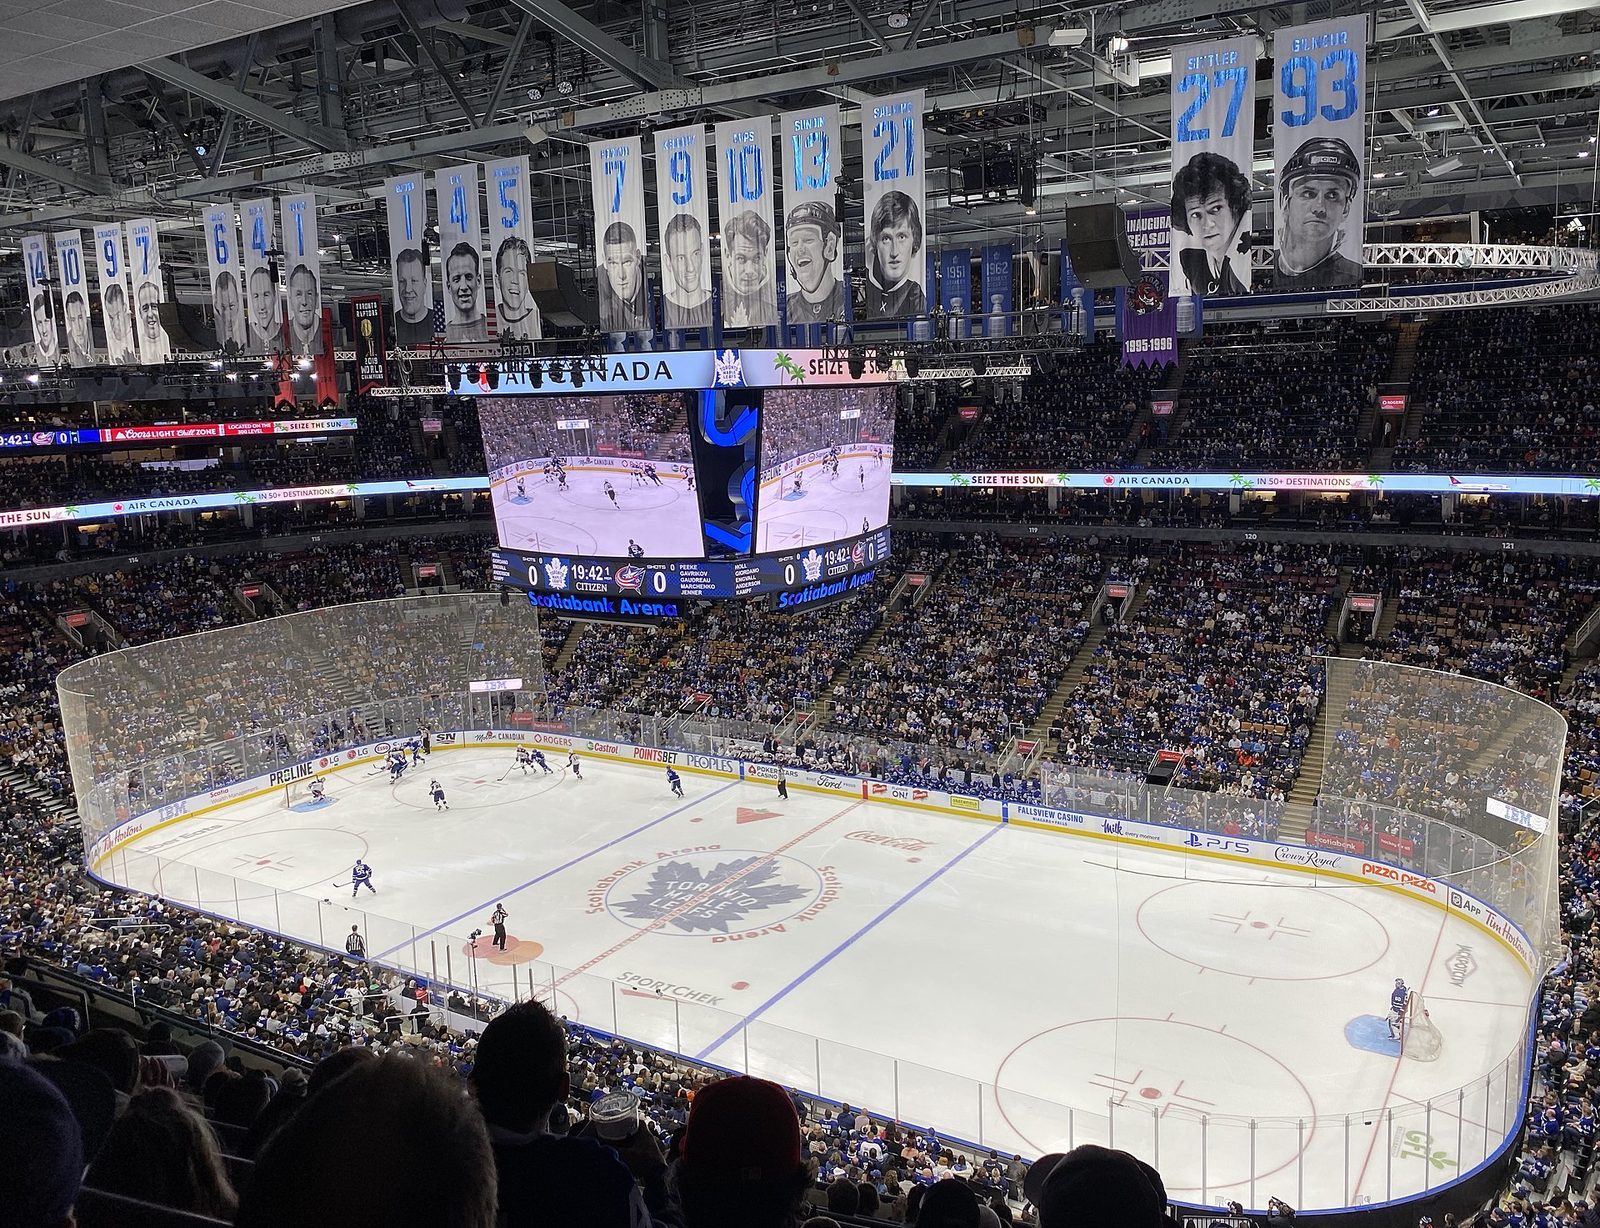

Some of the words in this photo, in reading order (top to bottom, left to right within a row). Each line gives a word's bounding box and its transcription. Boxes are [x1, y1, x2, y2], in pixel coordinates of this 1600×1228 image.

[1280, 48, 1360, 128] 93
[1176, 66, 1249, 144] 27
[873, 117, 916, 182] 21
[791, 131, 831, 192] 13
[670, 149, 693, 206] 9
[725, 144, 764, 204] 10
[604, 159, 627, 213] 7
[449, 186, 468, 234] 4
[498, 178, 520, 229] 5
[402, 194, 413, 241] 1
[1127, 215, 1172, 232] INAUGURA
[251, 216, 267, 259] 4
[294, 213, 305, 256] 1
[213, 223, 230, 265] 6
[103, 239, 118, 278] 9
[135, 235, 150, 276] 7
[27, 250, 46, 288] 14
[61, 248, 81, 286] 10
[946, 265, 966, 278] 1951
[986, 261, 1009, 275] 1962
[1124, 337, 1173, 353] 1995-1996
[360, 364, 383, 375] WORLD
[364, 357, 379, 366] 2019
[809, 358, 844, 376] SEIZE
[124, 429, 152, 440] Coors
[151, 430, 176, 438] LIGHT
[196, 428, 217, 436] ZONE
[290, 422, 310, 430] SEIZE
[60, 433, 68, 444] 0
[971, 475, 998, 485] SEIZE
[1000, 475, 1020, 484] THE
[1022, 475, 1044, 484] SUN
[1119, 476, 1139, 485] AIR
[1141, 476, 1190, 485] CANADA
[1257, 477, 1266, 485] IN
[1268, 477, 1284, 485] 50+
[1286, 477, 1351, 487] DESTINATIONS
[283, 488, 335, 498] DESTINATIONS
[128, 502, 147, 510] AIR
[149, 498, 198, 508] CANADA
[0, 513, 22, 524] THE
[26, 511, 51, 521] SUN
[868, 542, 874, 562] 0
[1501, 541, 1514, 550] 121
[824, 546, 846, 566] 19:42
[846, 546, 850, 556] 1
[528, 565, 538, 586] 0
[571, 563, 604, 581] 19:42
[604, 566, 610, 576] 1
[670, 563, 675, 571] 0
[734, 567, 760, 577] GIORDANO
[784, 563, 795, 586] 0
[827, 563, 849, 576] CITIZEN
[575, 581, 608, 592] CITIZEN
[653, 571, 667, 593] 0
[735, 574, 757, 583] ENGVALL
[735, 580, 761, 589] ANDERSON
[735, 587, 752, 596] KAMPF
[778, 576, 849, 609] Scotiabank
[849, 569, 876, 590] Arena
[527, 590, 616, 614] Scotiabank
[620, 598, 678, 617] Arena
[484, 680, 507, 690] IBM
[436, 732, 456, 742] SN
[498, 732, 525, 741] CANADIAN
[543, 736, 573, 747] ROGERS
[358, 748, 369, 757] LG
[594, 742, 619, 755] Castrol
[633, 747, 678, 764] POINTSBET
[329, 756, 340, 765] LG
[687, 754, 733, 773] PEOPLES
[269, 761, 313, 787] PROLINE
[757, 771, 779, 780] CASINO
[817, 774, 843, 789] Ford
[209, 788, 229, 798] Scotia
[891, 790, 909, 799] ON!
[159, 801, 188, 822] IBM
[1017, 805, 1056, 819] FALLSVIEW
[1057, 812, 1084, 824] CASINO
[1504, 804, 1532, 828] IBM
[1100, 819, 1124, 836] Milk
[1207, 837, 1250, 853] PS5
[1314, 834, 1356, 851] Scotiabank
[1274, 846, 1306, 862] Crown
[1304, 851, 1341, 868] Royal
[585, 858, 648, 915] Scotiabank
[656, 843, 721, 860] Arena
[1362, 862, 1399, 880] pizza
[1401, 873, 1436, 894] pizza
[664, 890, 733, 910] MALE
[665, 880, 758, 907] TORNTO
[793, 864, 844, 923] Scotiabank
[649, 898, 714, 920] LEFS
[1485, 910, 1502, 936] Tim
[711, 923, 787, 945] Arena
[616, 971, 726, 1006] SPORTCHEK
[1400, 1130, 1434, 1159] GFL
